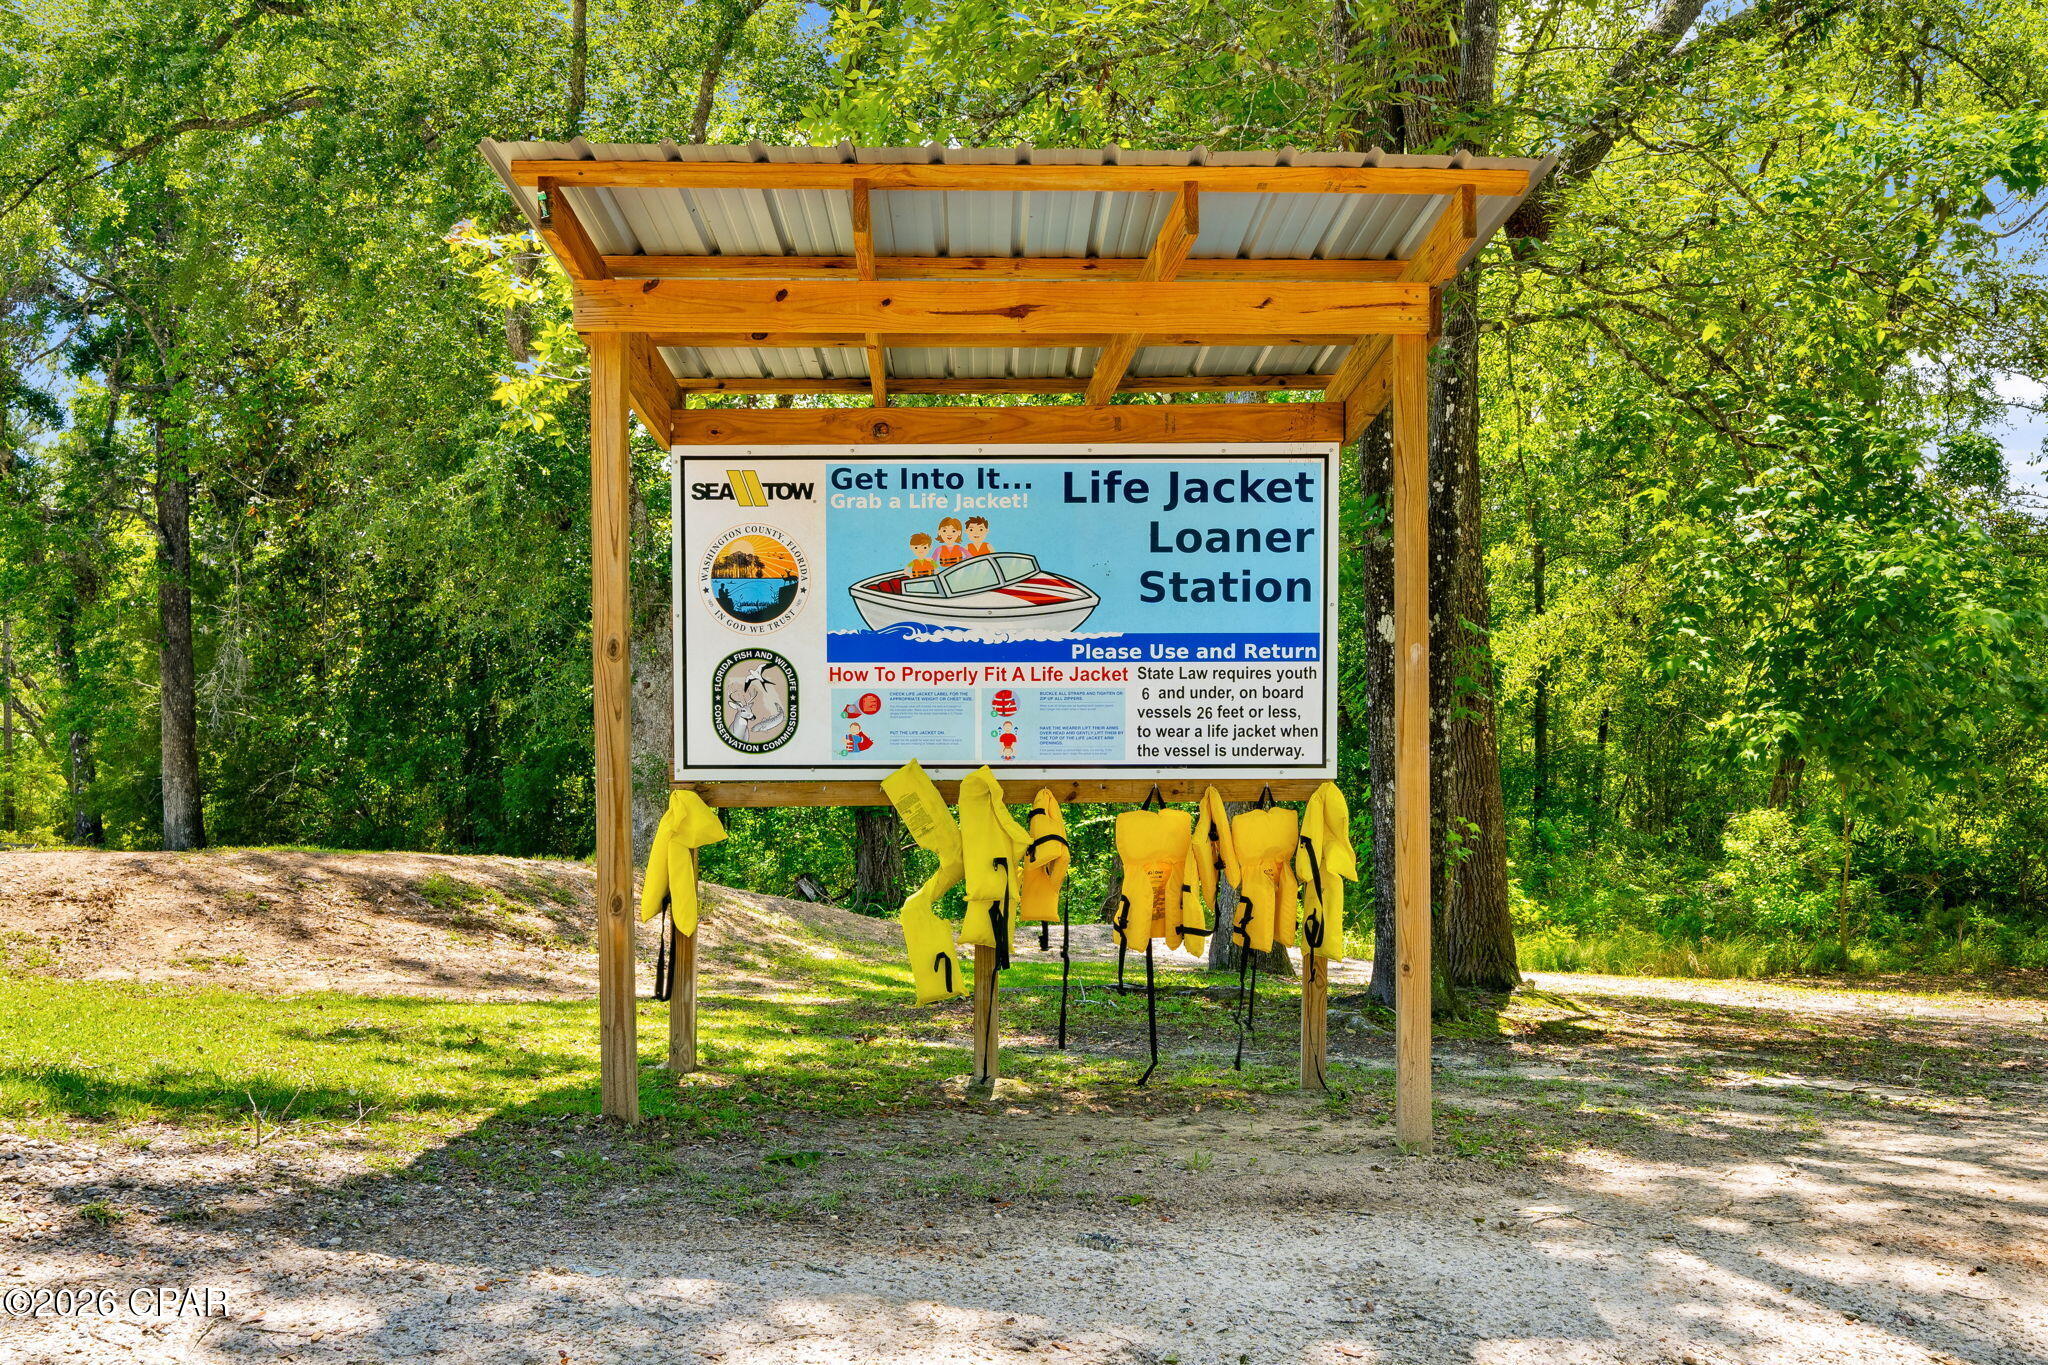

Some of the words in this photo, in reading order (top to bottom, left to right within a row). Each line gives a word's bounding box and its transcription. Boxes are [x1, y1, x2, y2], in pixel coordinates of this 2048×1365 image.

[832, 468, 888, 490] Get
[901, 468, 965, 490] Into
[978, 468, 1032, 490] It...
[691, 482, 736, 501] SEA
[761, 482, 815, 501] TOW
[1064, 470, 1150, 503] Life
[1164, 470, 1315, 511] Jacket
[831, 493, 882, 509] Grab
[889, 497, 901, 509] a
[909, 493, 948, 509] Life
[954, 493, 1029, 512] Jacket!
[1150, 522, 1314, 553] Loaner
[701, 527, 742, 582] WASHINGTON
[744, 525, 785, 544] COUNTY,
[786, 540, 808, 582] FLORIDA
[1140, 570, 1312, 603] Station
[714, 610, 726, 622] IN
[726, 619, 747, 632] GOD
[750, 625, 765, 634] WE
[767, 609, 796, 631] TRUST
[1072, 643, 1142, 659] Please
[1151, 644, 1189, 660] Use
[1197, 643, 1236, 660] and
[1245, 643, 1318, 660] Return
[714, 658, 734, 692] FLORIDA
[733, 650, 753, 662] FISH
[754, 650, 773, 660] AND
[774, 655, 797, 692] WILDLIFE
[830, 666, 870, 682] How
[874, 666, 896, 682] To
[902, 666, 978, 686] Properly
[985, 666, 1008, 682] Fit
[1011, 666, 1026, 682] A
[1031, 666, 1064, 682] Life
[1069, 666, 1129, 682] Jacket
[1138, 667, 1174, 680] State
[1180, 667, 1208, 680] Law
[1213, 667, 1272, 683] requires
[1276, 667, 1317, 683] youth
[1141, 688, 1150, 701] 6
[1158, 686, 1185, 700] and
[1191, 686, 1235, 702] under,
[1240, 689, 1257, 700] on
[1262, 686, 1304, 700] board
[1138, 705, 1192, 719] vessels
[1197, 706, 1213, 720] 26
[1217, 705, 1245, 719] feet
[1249, 708, 1264, 719] or
[1269, 705, 1301, 721] less,
[714, 705, 759, 752] CONSERVATION
[762, 704, 797, 751] COMMISSION
[1138, 725, 1152, 739] to
[1156, 727, 1191, 739] wear
[1194, 727, 1203, 739] a
[1208, 724, 1229, 738] life
[1232, 724, 1276, 742] jacket
[1281, 724, 1318, 738] when
[1137, 743, 1160, 758] the
[1164, 743, 1210, 758] vessel
[1216, 743, 1227, 758] is
[1231, 743, 1305, 761] underway.
